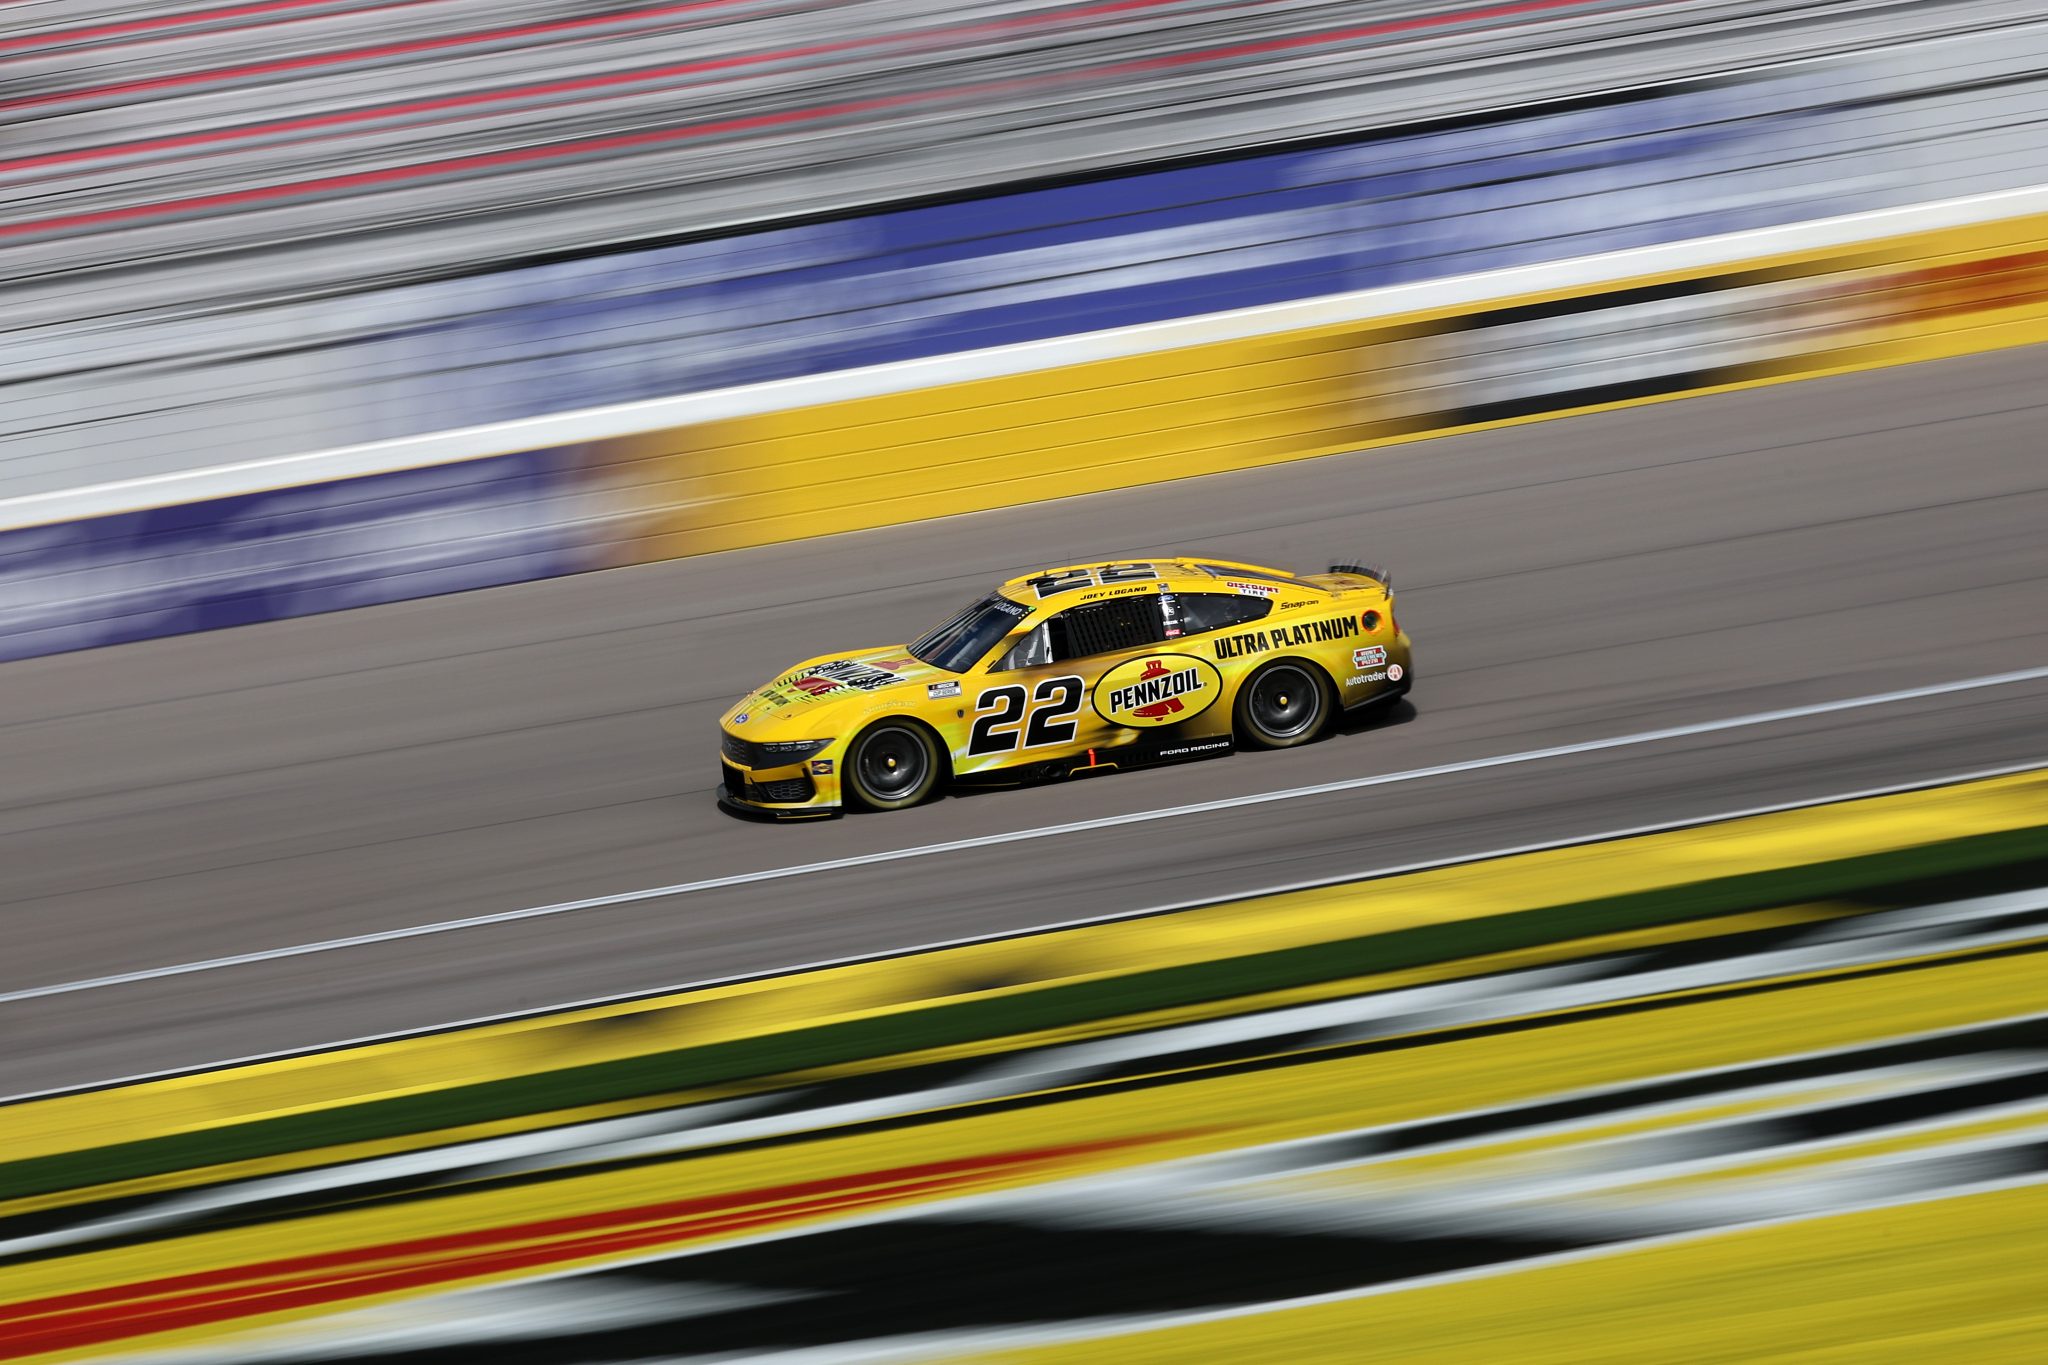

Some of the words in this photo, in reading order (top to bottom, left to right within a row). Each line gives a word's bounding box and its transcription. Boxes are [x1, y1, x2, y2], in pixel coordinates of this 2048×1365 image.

[1080, 591, 1106, 601] JOEY
[1108, 586, 1148, 596] LOGANO
[1226, 581, 1280, 594] DISCOUNT
[1241, 588, 1265, 597] TIRE
[1214, 631, 1270, 660] ULTRA
[1270, 615, 1360, 650] PLATINUM
[1345, 671, 1387, 687] Autotrader
[1109, 667, 1203, 715] PENNZOIL
[967, 675, 1085, 759] 22
[1160, 747, 1189, 757] FORD
[1190, 741, 1230, 752] RACING
